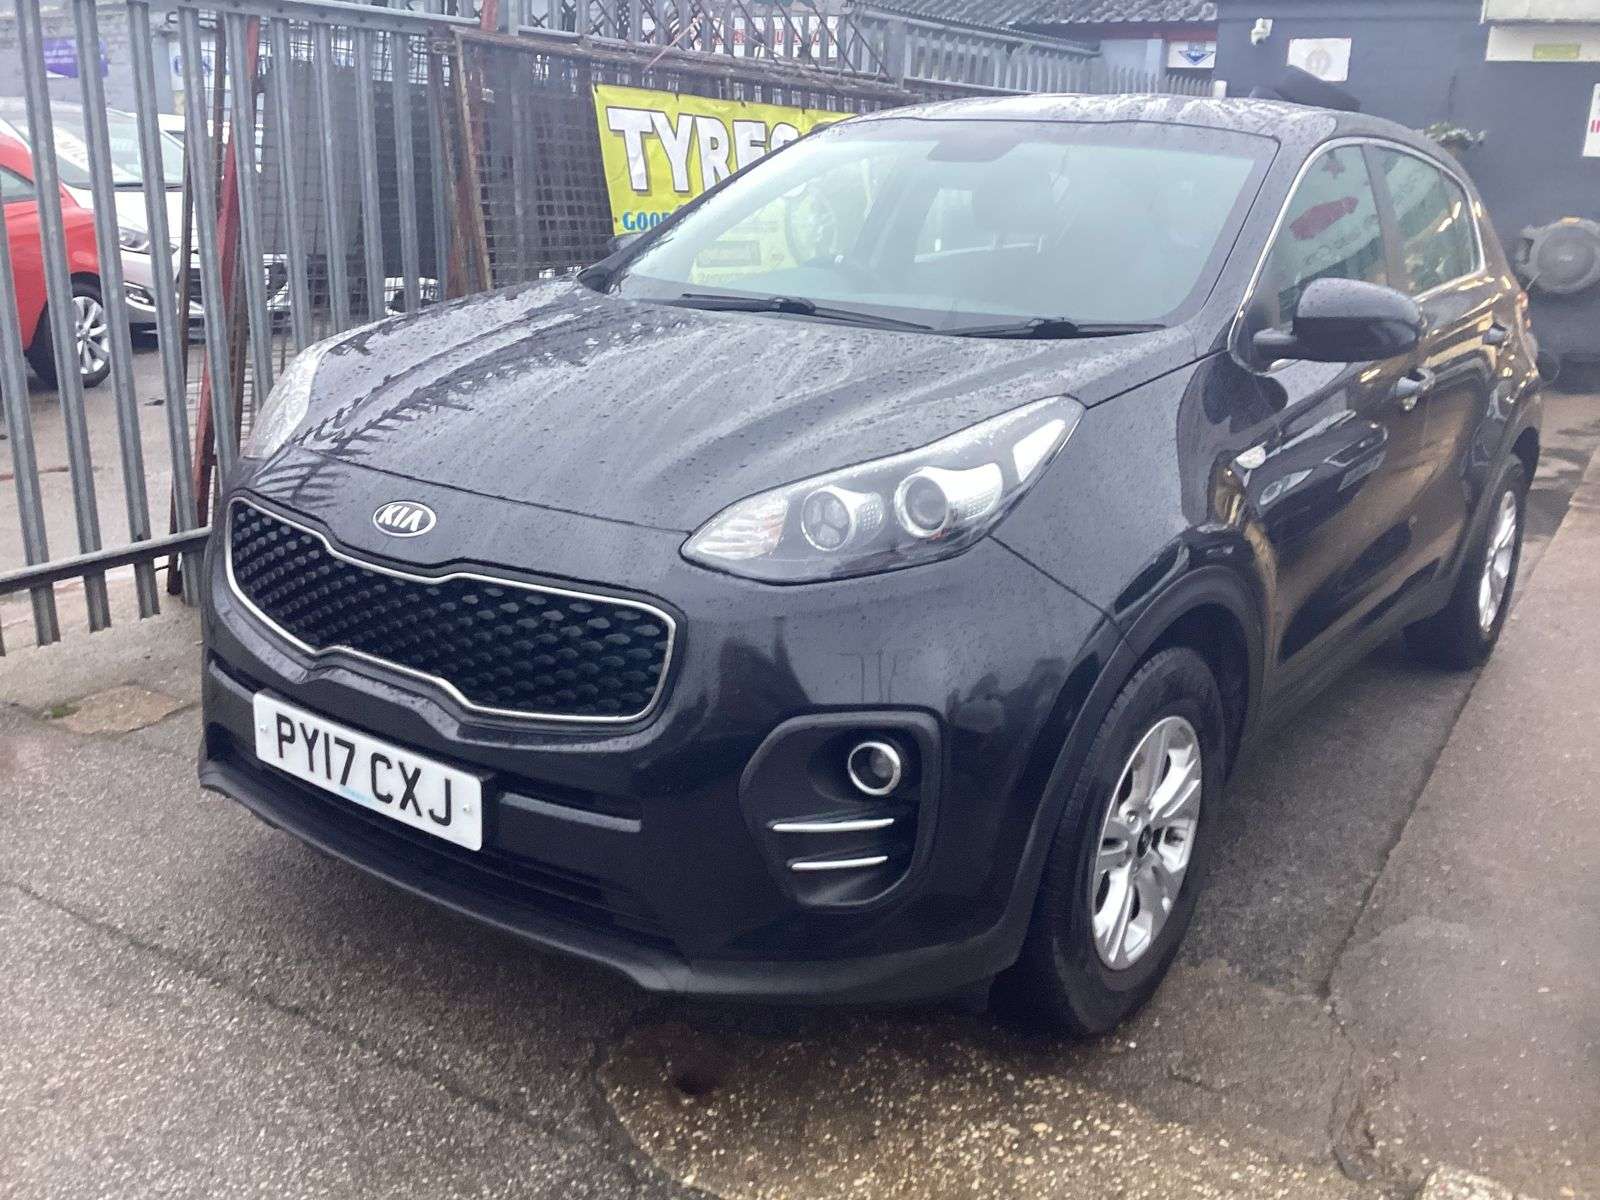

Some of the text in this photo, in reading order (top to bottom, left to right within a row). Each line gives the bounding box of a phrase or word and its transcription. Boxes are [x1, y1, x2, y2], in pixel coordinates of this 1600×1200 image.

[377, 504, 424, 532] KIA
[276, 712, 453, 827] PY17 CXJ
